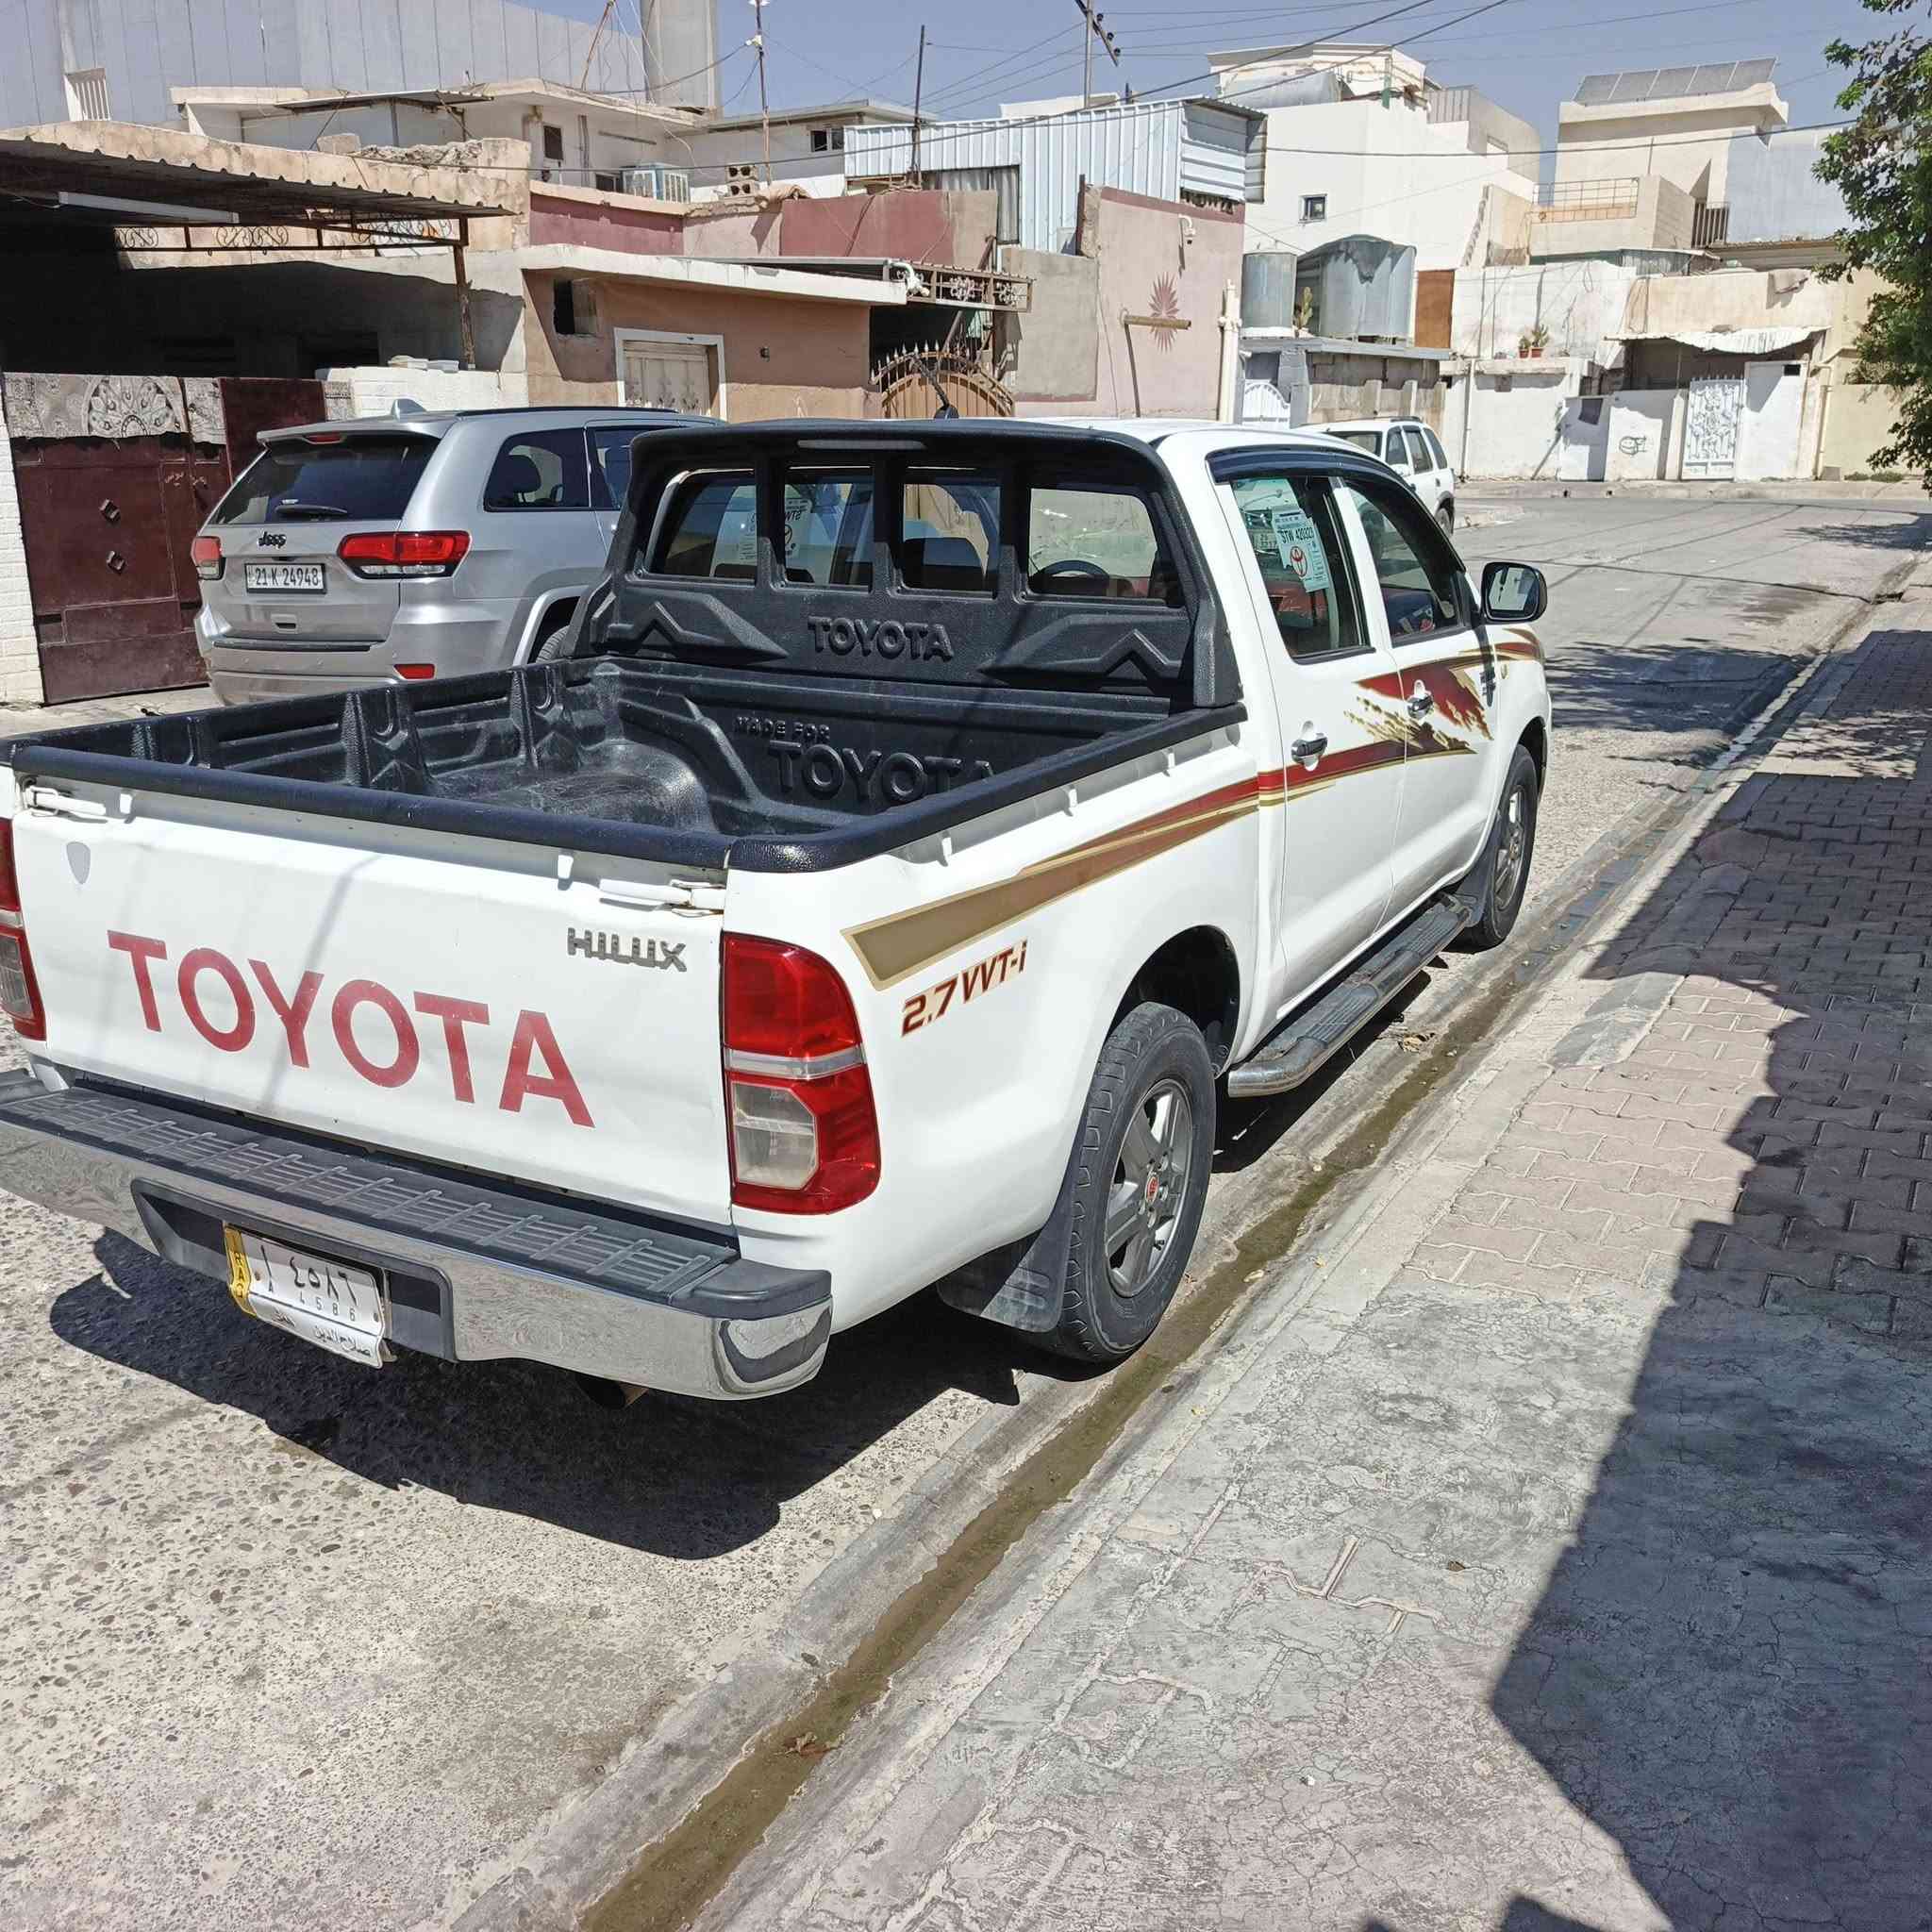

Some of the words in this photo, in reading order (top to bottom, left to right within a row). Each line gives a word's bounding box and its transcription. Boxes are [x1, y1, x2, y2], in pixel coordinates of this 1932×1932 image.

[258, 531, 287, 549] Jeep
[255, 567, 268, 586] 21
[271, 567, 280, 586] K
[282, 567, 320, 587] 24948
[808, 615, 954, 662] TOYOTA
[734, 715, 787, 738] MADE
[792, 721, 830, 742] FOR
[567, 927, 688, 973] HILUX
[901, 975, 959, 1038] 2.7
[107, 929, 596, 1129] TOYOTA
[298, 1291, 357, 1323] 4586
